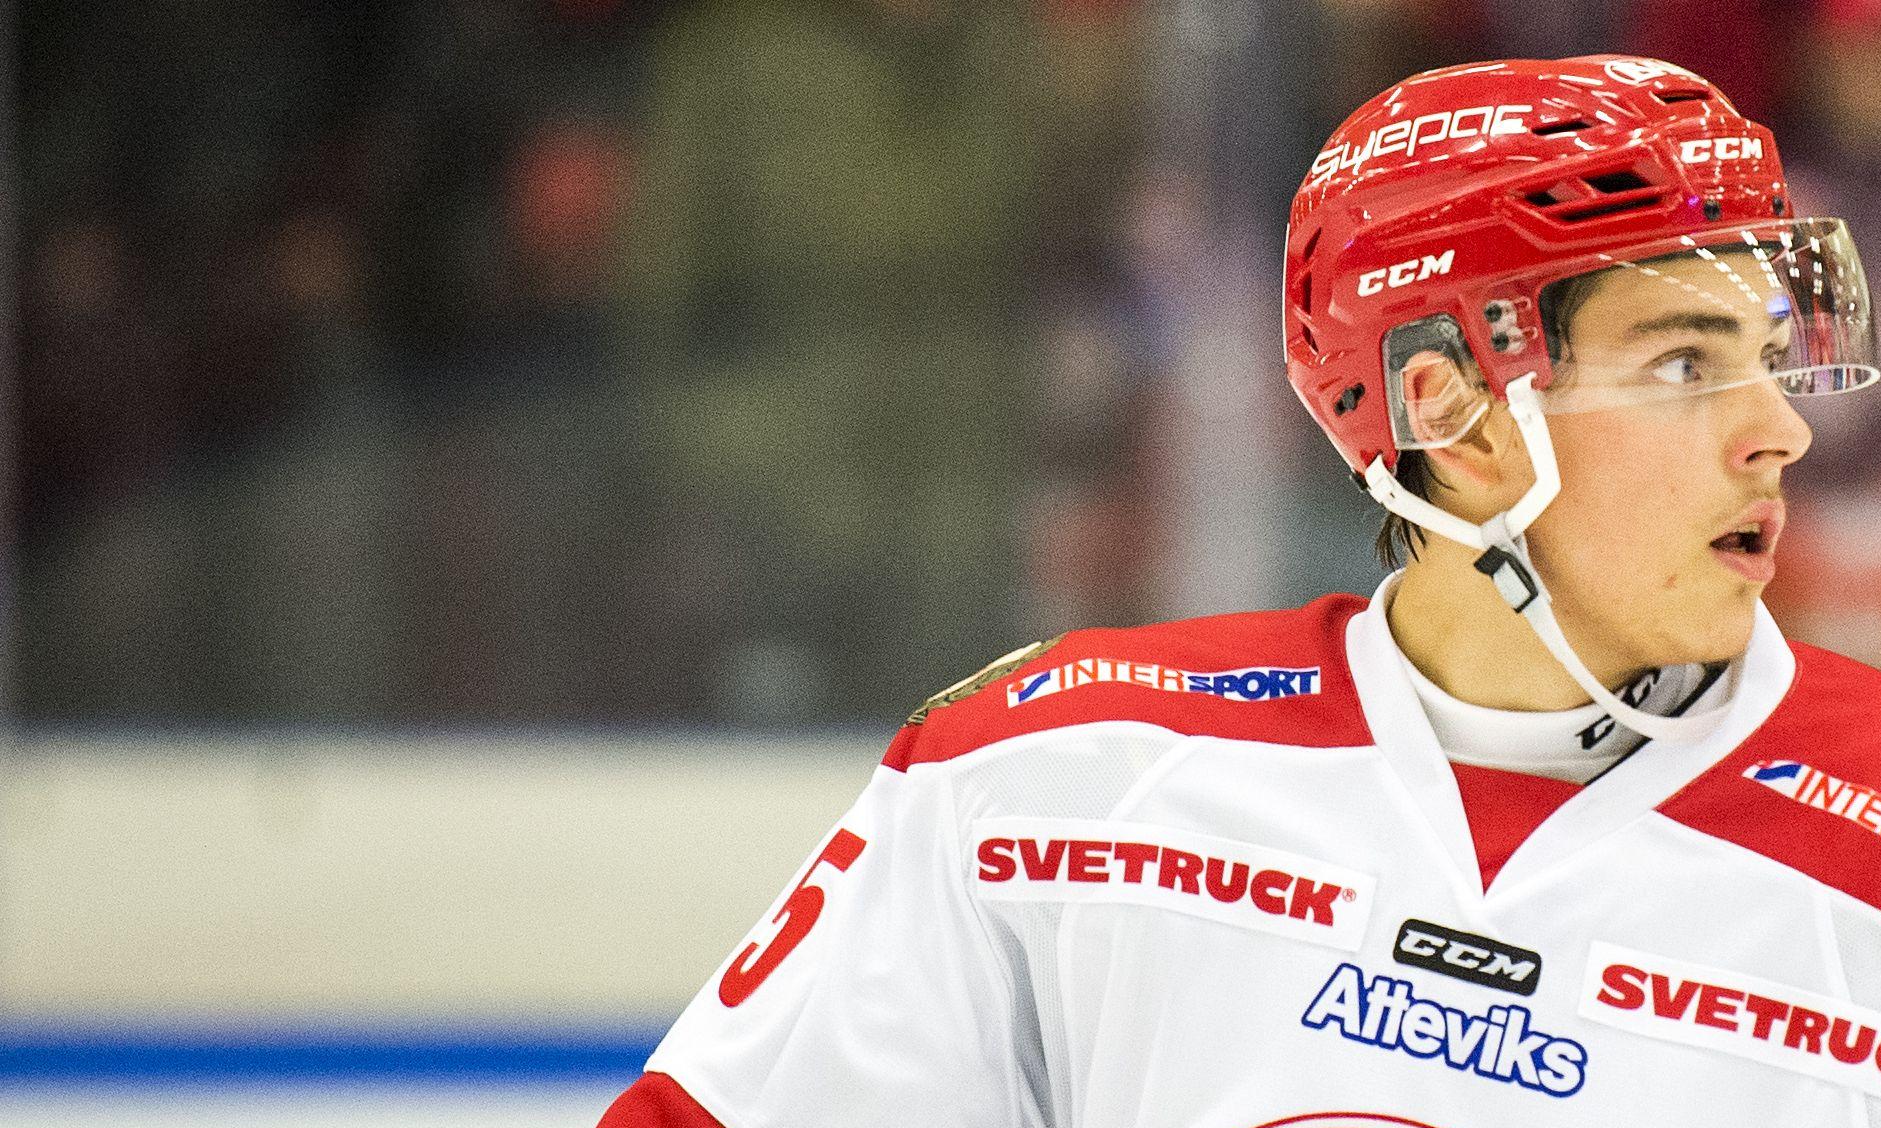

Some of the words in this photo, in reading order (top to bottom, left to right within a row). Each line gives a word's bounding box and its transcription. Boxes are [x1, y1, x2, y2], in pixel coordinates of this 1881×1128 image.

[1679, 137, 1763, 164] CCM
[1356, 248, 1455, 297] CCM
[1057, 657, 1319, 700] INTERSPORT
[718, 827, 867, 1008] 5
[1400, 929, 1537, 983] CCM
[1301, 962, 1589, 1099] Atteviks
